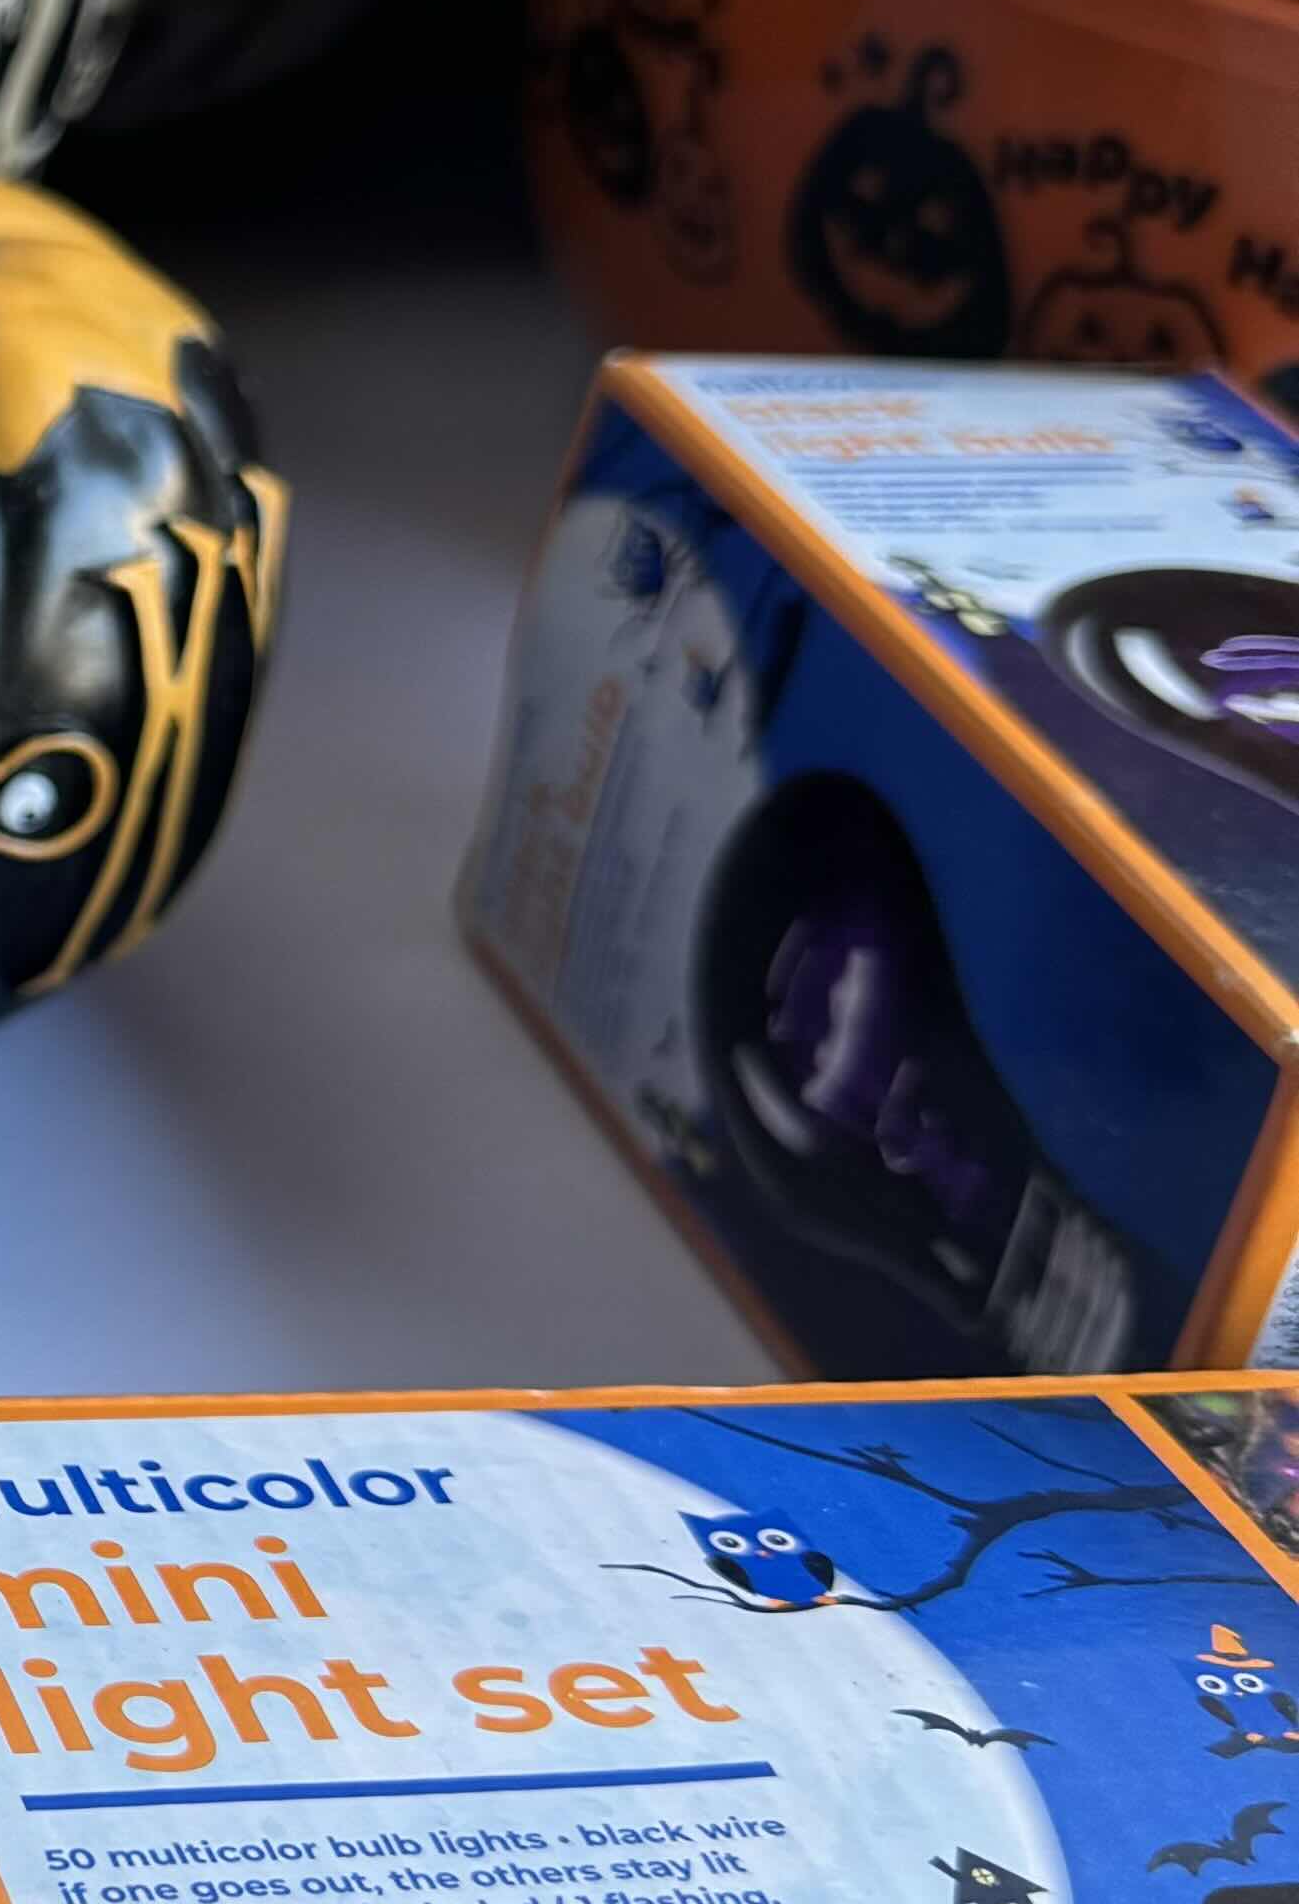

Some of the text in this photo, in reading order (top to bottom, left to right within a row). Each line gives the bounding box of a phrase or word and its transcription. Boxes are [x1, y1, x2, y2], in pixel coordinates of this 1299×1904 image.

[452, 1645, 742, 1734] set
[45, 1815, 787, 1872] 50 multicolor bulb lights black wire
[100, 1881, 180, 1904] one
[190, 1877, 292, 1904] goes
[301, 1871, 384, 1897] out,
[388, 1865, 461, 1892] the
[470, 1862, 603, 1889] others
[609, 1856, 693, 1883] stay
[699, 1849, 748, 1876] lit
